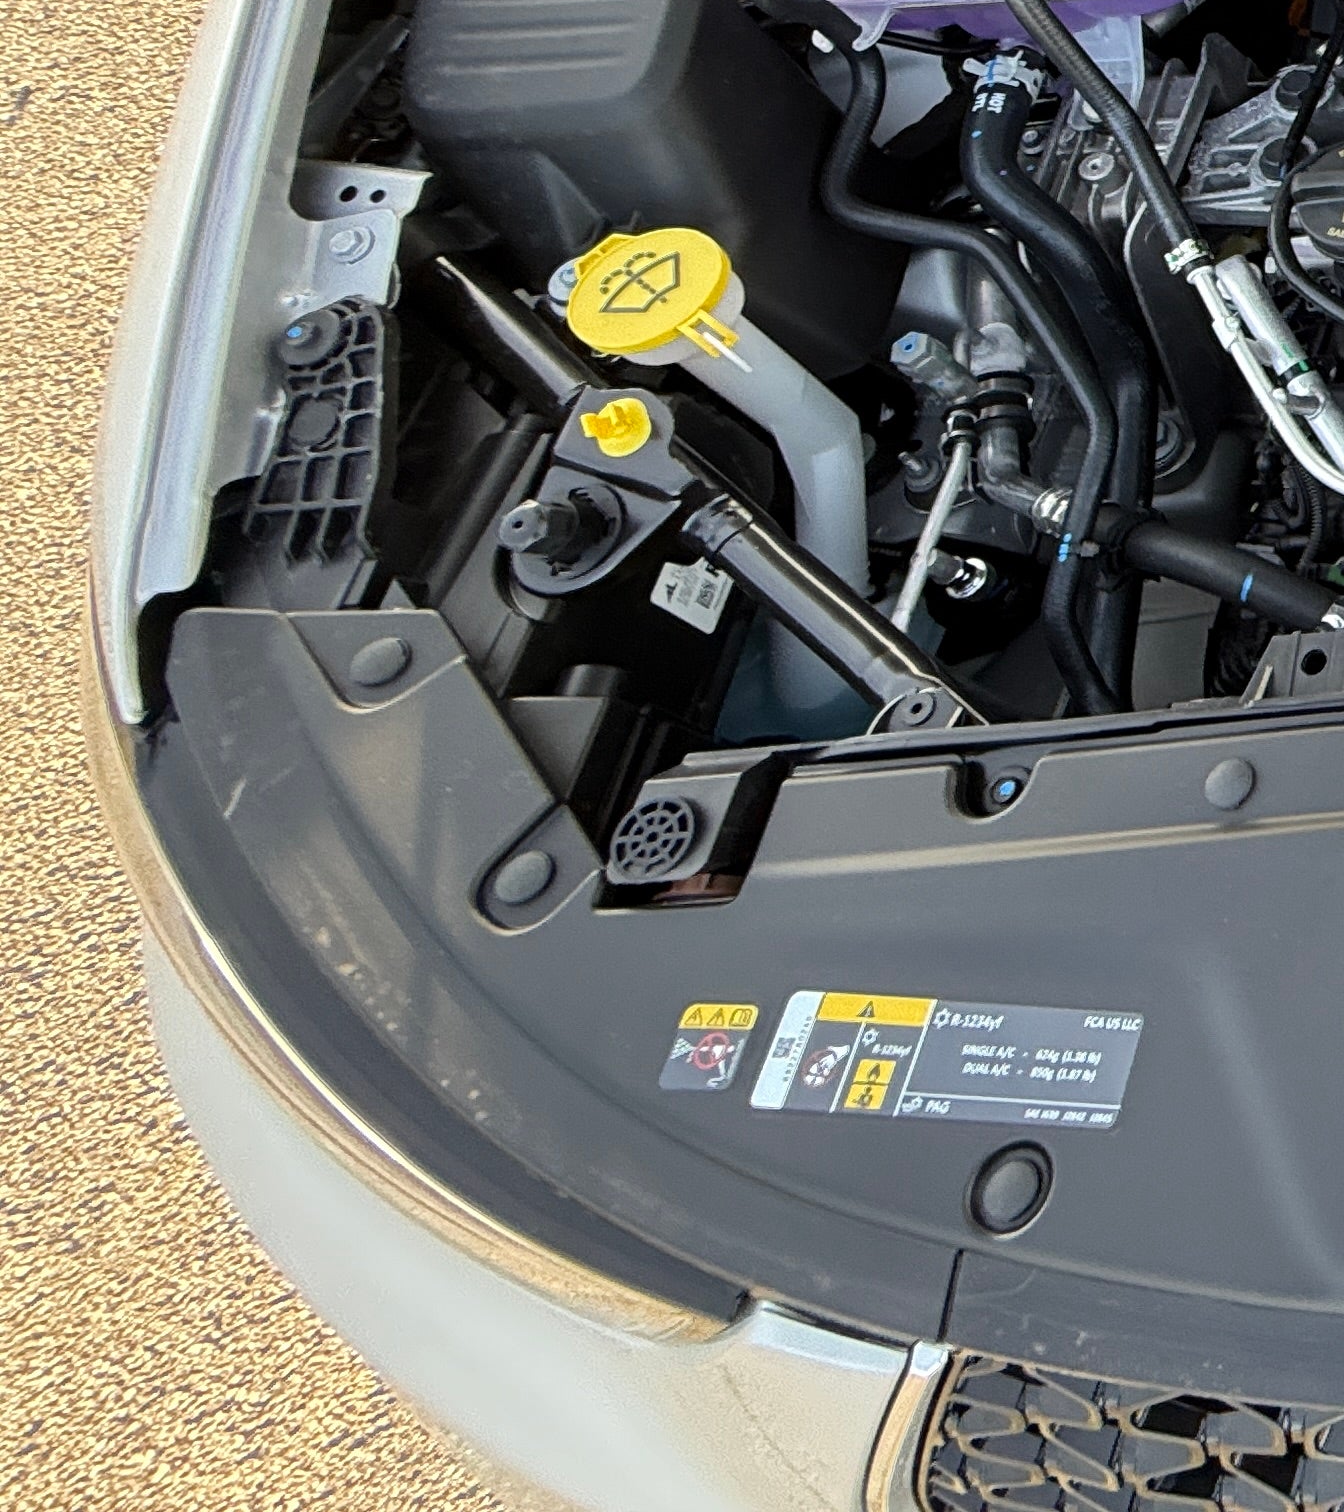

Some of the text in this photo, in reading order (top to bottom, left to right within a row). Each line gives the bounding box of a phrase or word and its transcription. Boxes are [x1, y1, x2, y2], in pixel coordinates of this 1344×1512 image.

[951, 1013, 1004, 1032] R-1234yf
[1083, 1016, 1141, 1031] FCA US LLC
[961, 1044, 997, 1057] SINGLE
[996, 1045, 1017, 1059] A/C
[961, 1062, 992, 1075] DUAL
[992, 1063, 1011, 1077] A/C
[924, 1100, 951, 1114] PAG
